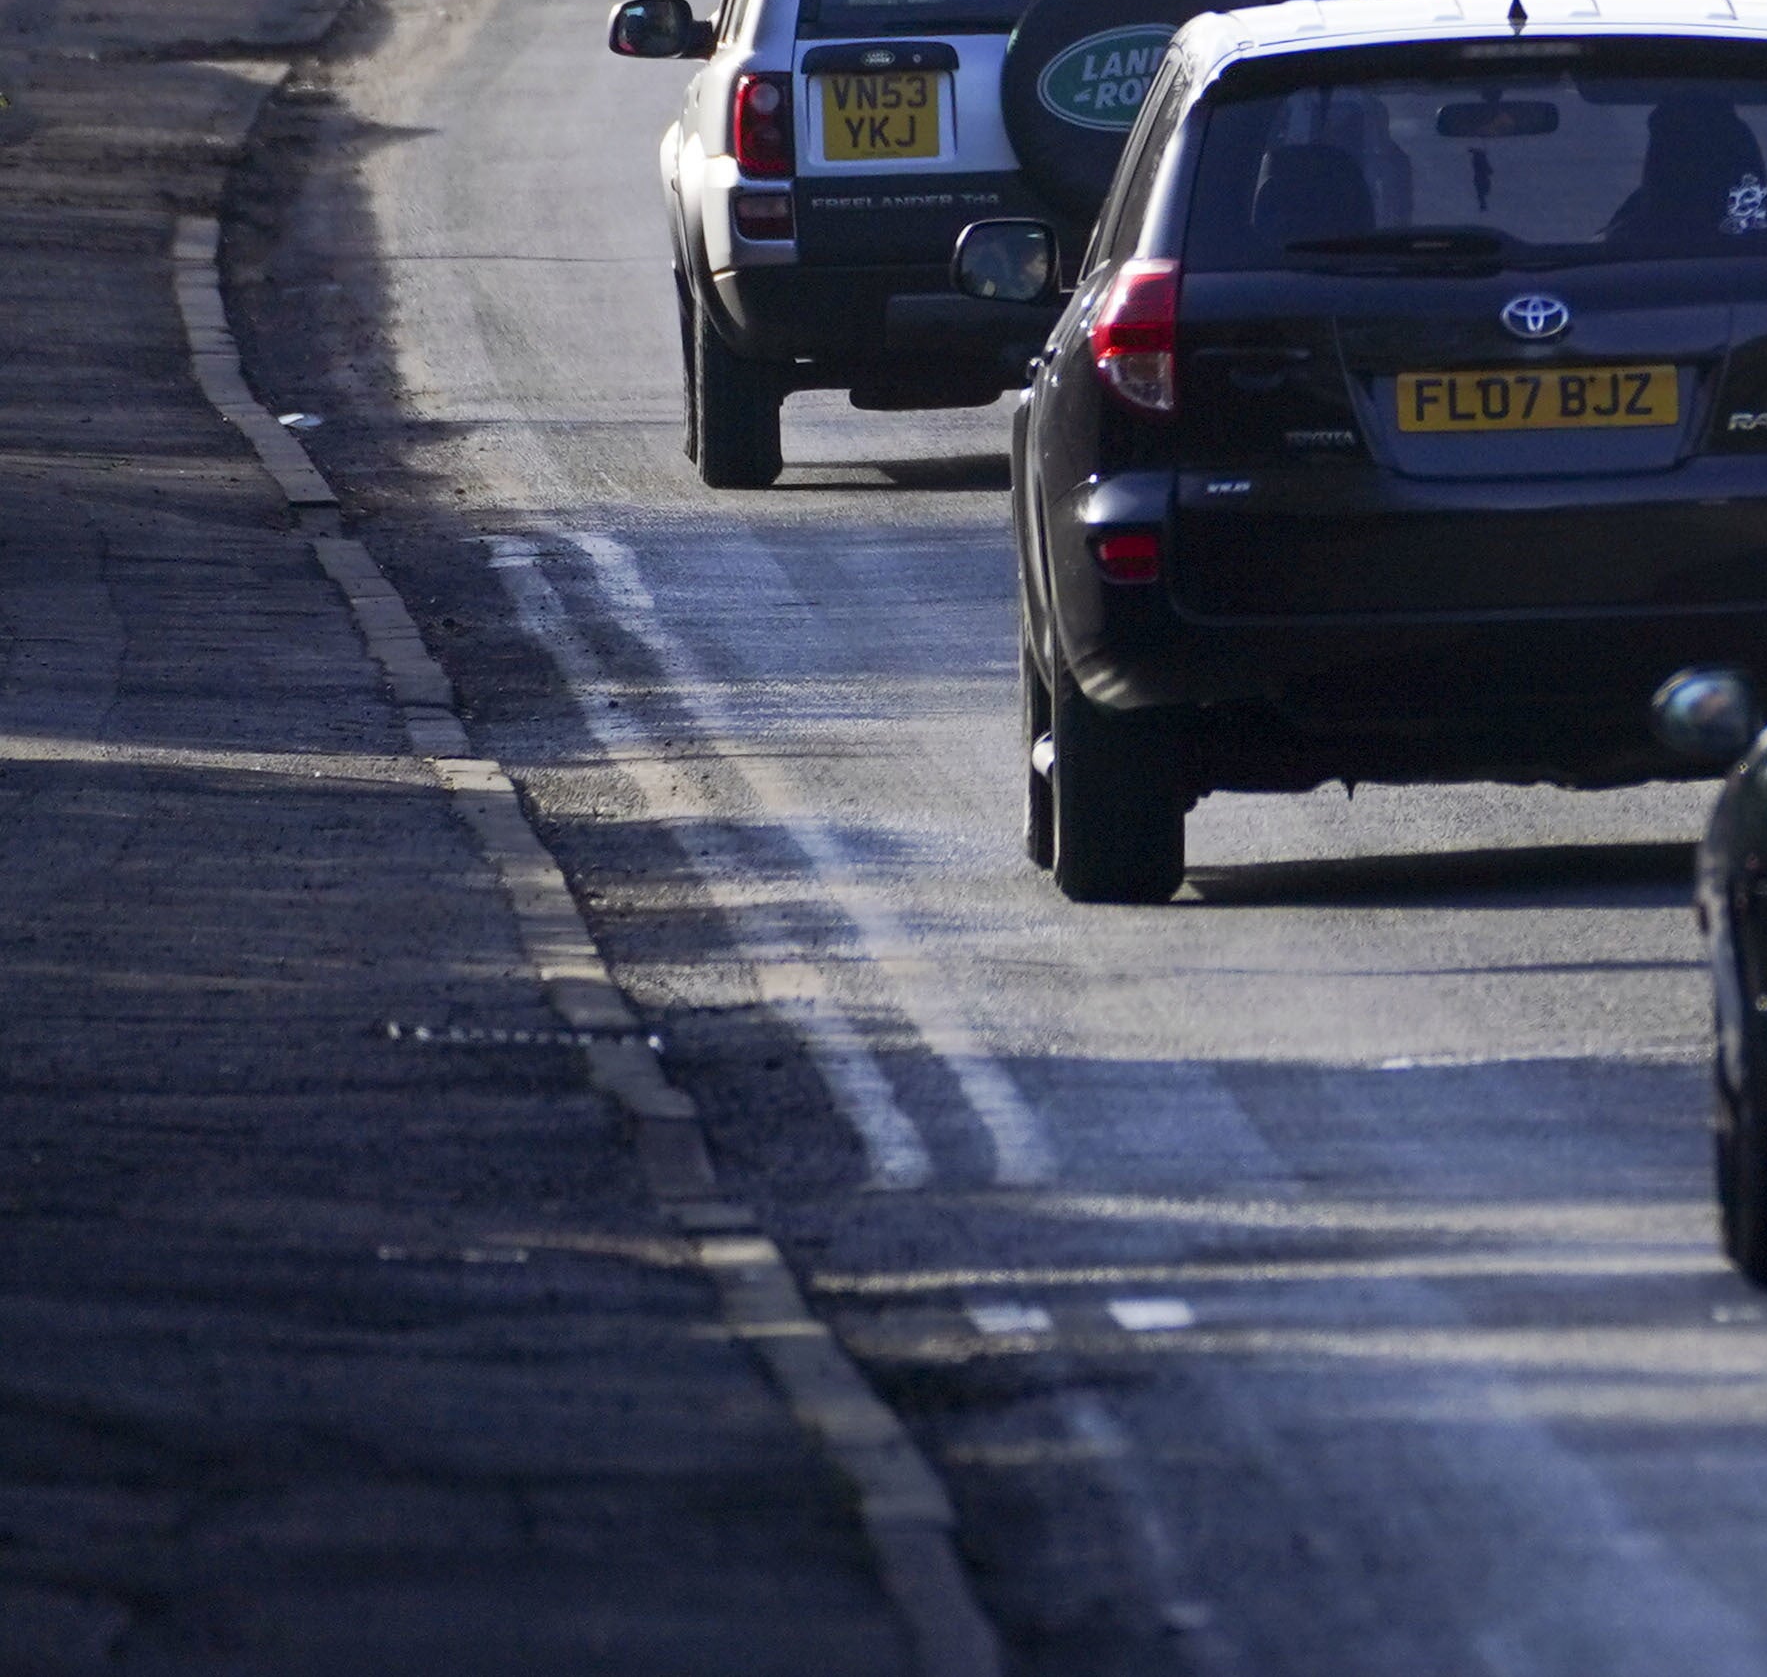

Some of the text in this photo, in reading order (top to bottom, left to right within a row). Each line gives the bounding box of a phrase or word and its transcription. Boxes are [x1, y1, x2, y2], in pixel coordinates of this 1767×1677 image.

[831, 74, 928, 111] VN53
[845, 115, 916, 148] YKJ
[1414, 373, 1653, 422] FL07 BJZ
